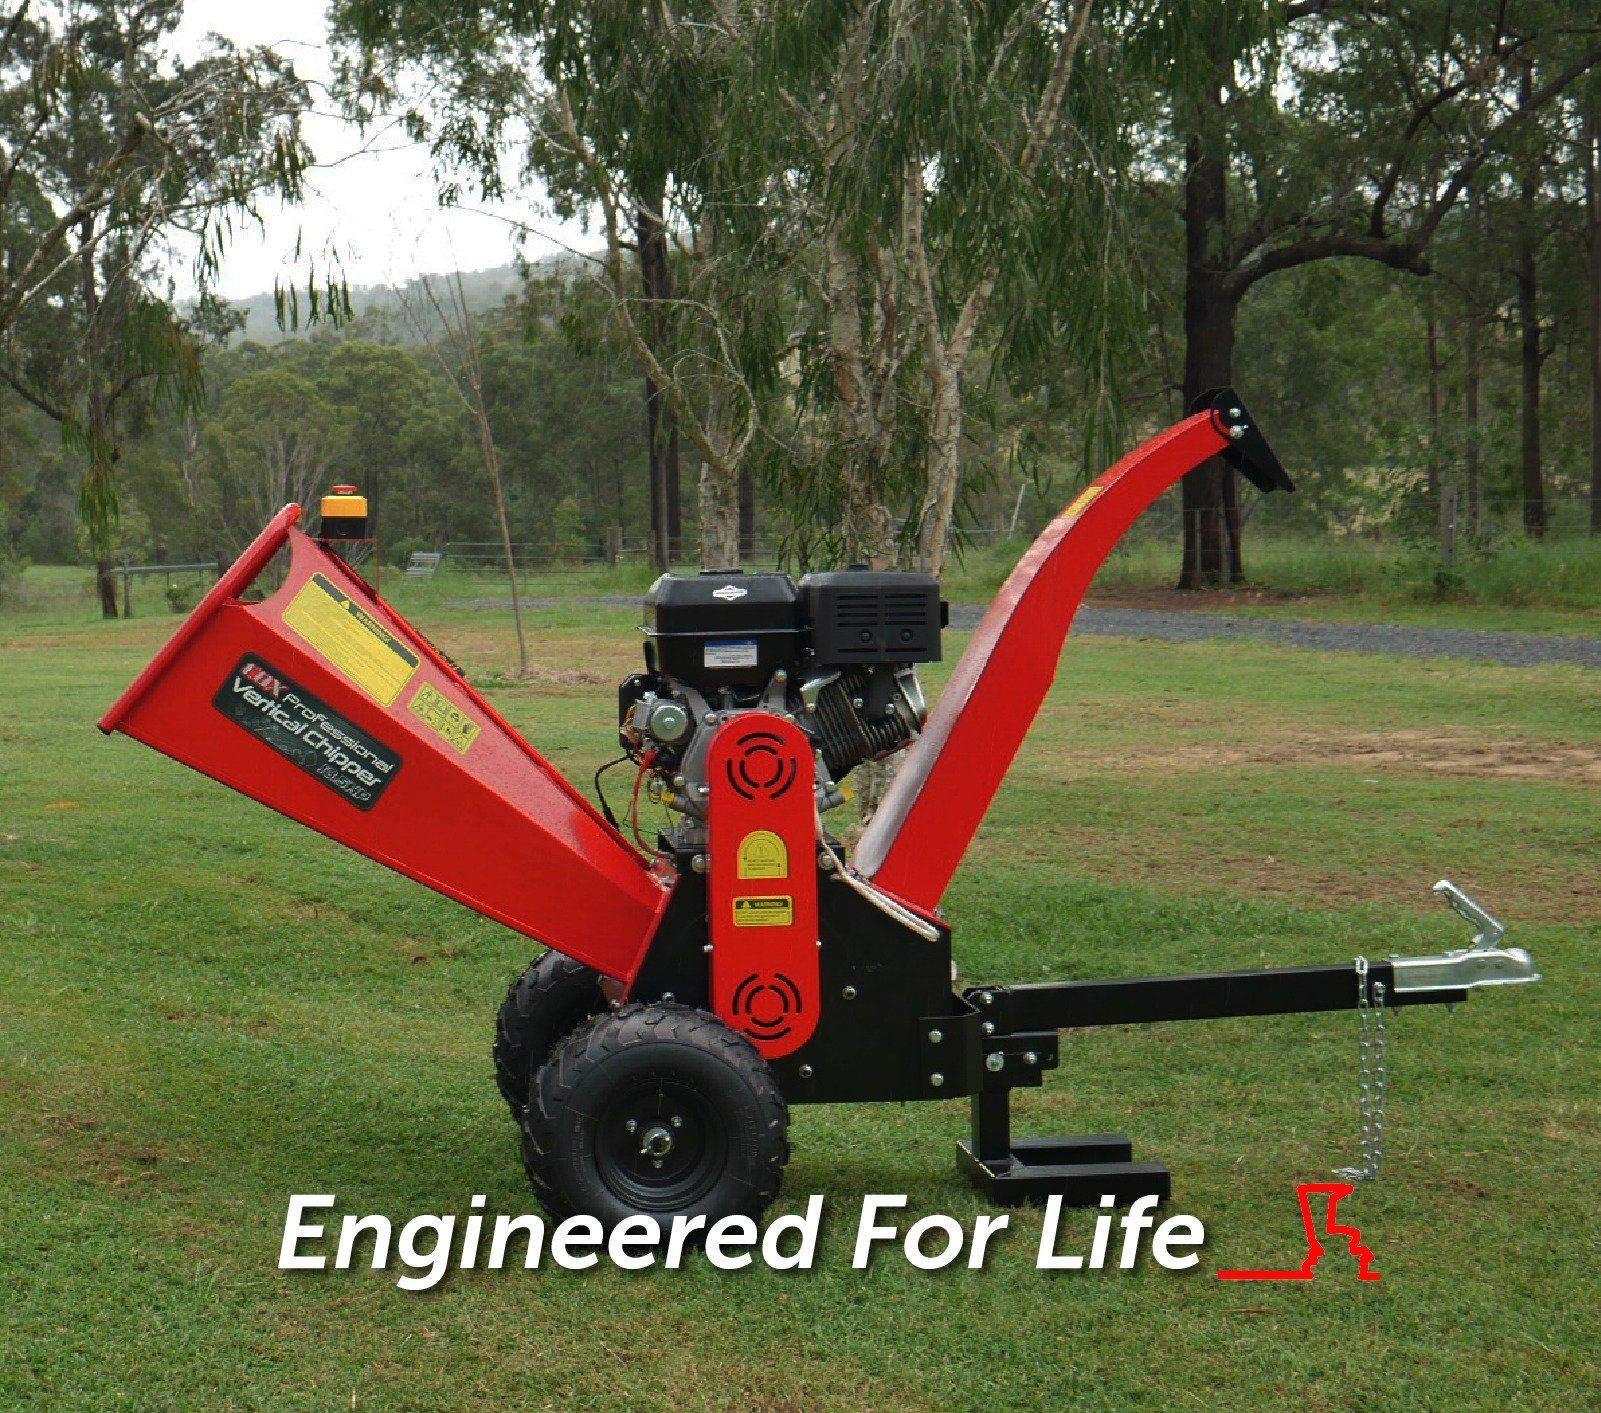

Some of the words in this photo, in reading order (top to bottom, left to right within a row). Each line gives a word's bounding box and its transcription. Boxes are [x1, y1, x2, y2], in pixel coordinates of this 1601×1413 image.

[232, 675, 309, 735] Vertical
[302, 730, 382, 786] Chipper
[283, 693, 395, 774] Professional
